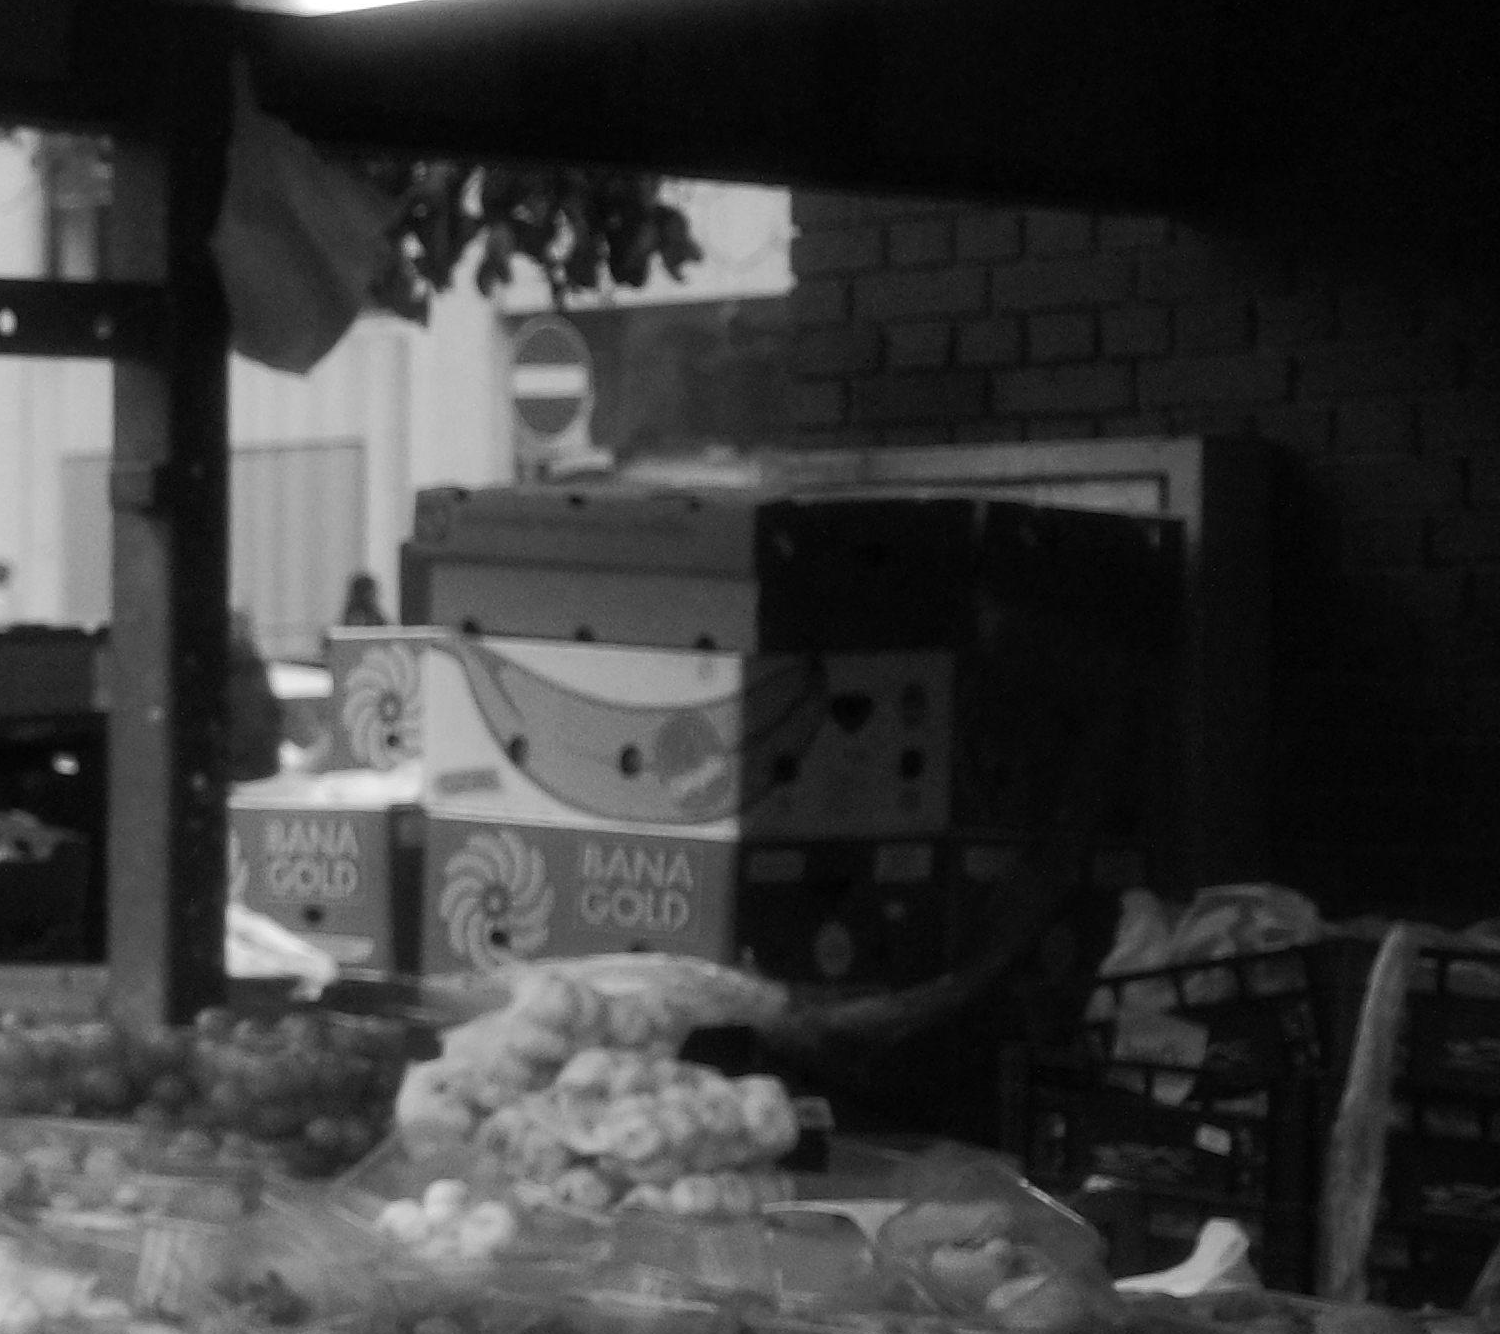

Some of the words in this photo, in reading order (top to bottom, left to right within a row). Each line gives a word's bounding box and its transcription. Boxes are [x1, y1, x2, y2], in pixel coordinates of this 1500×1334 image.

[264, 818, 360, 858] BANA
[267, 858, 359, 899] GOLD
[581, 842, 695, 892] BANA
[579, 884, 691, 933] GOLD
